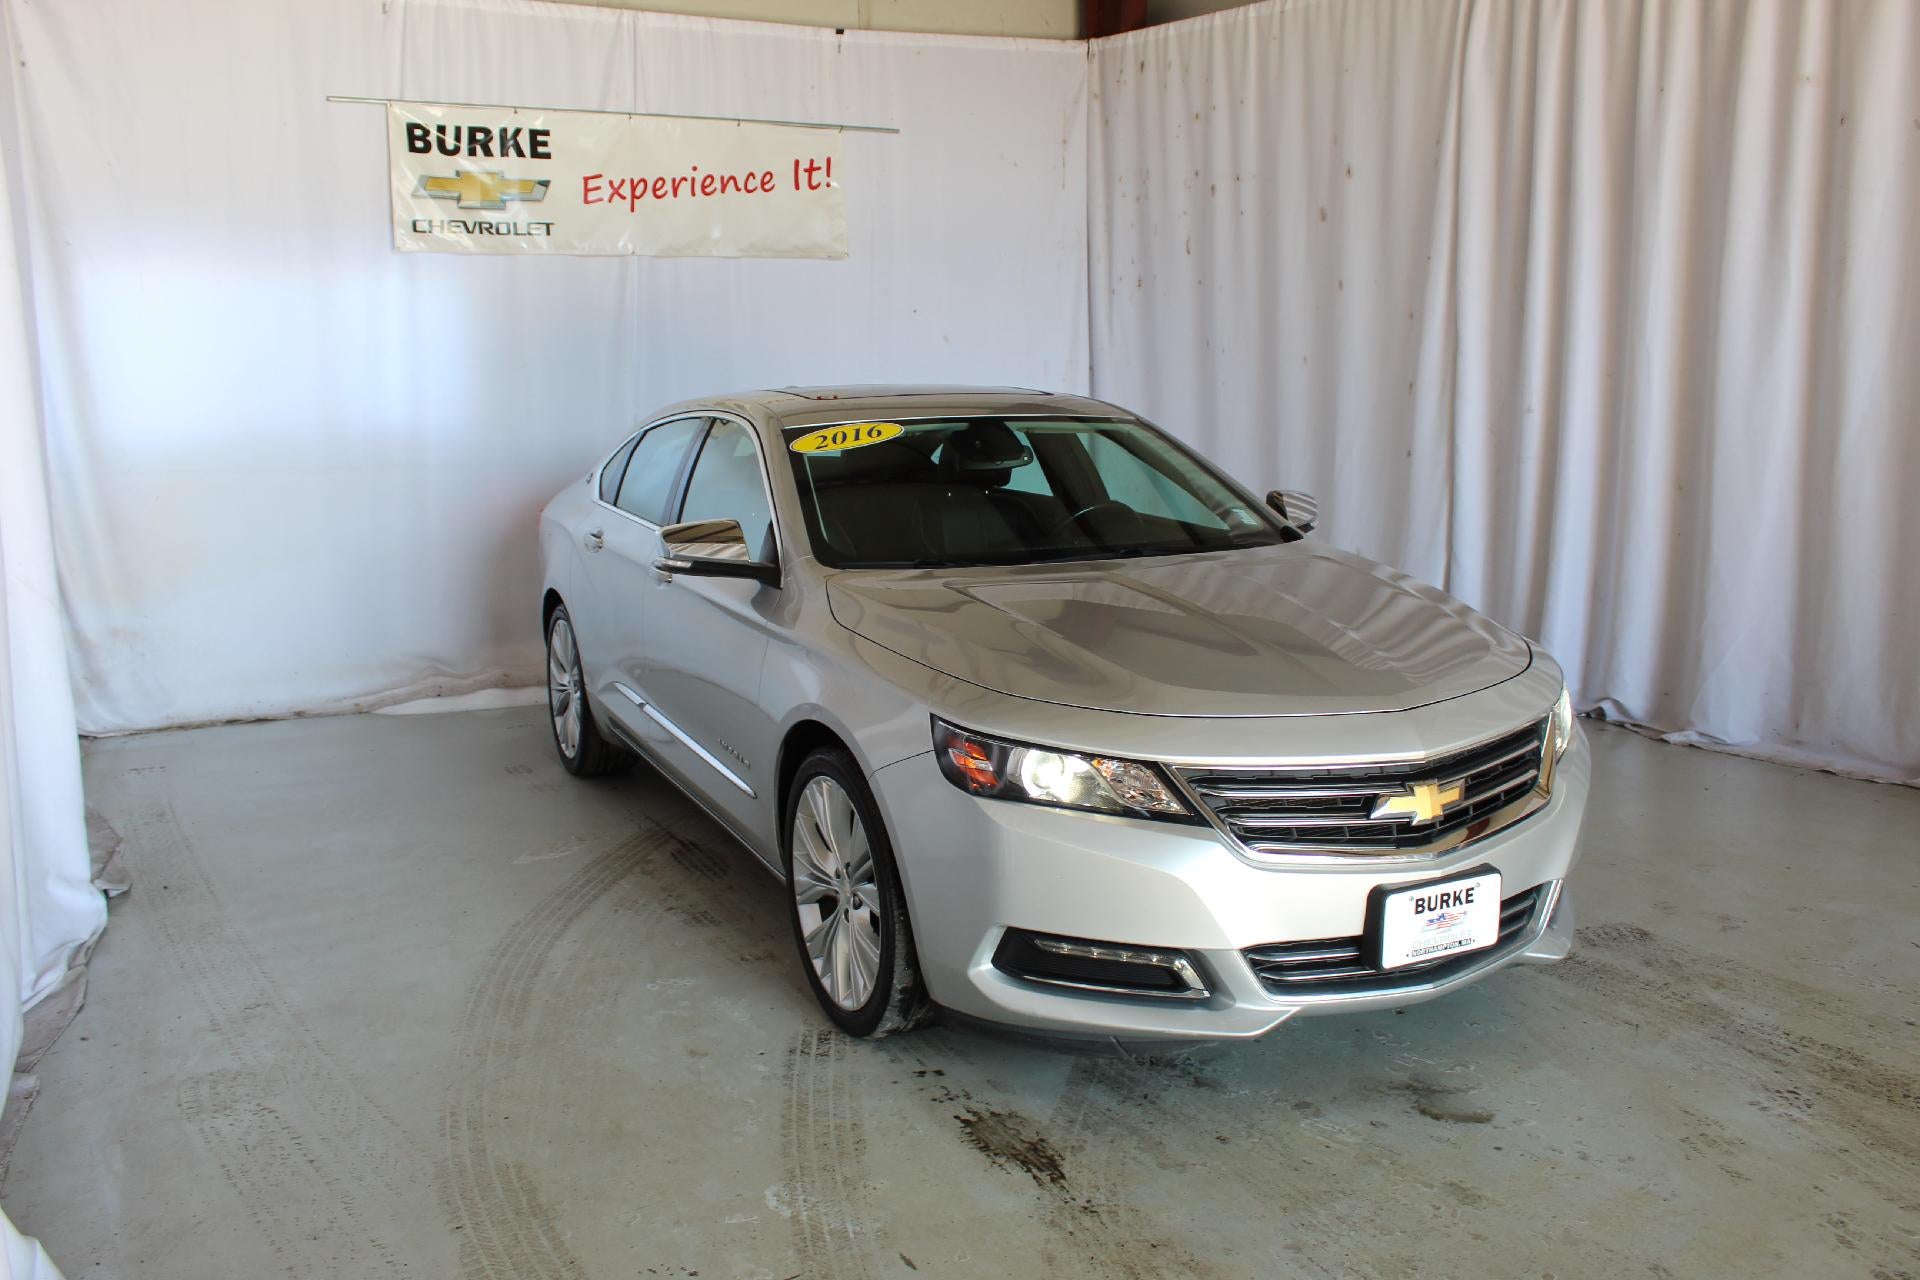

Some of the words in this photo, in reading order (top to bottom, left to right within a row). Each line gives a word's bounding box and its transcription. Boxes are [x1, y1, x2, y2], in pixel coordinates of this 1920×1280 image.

[405, 121, 552, 160] BURKE
[583, 165, 776, 213] Experience
[793, 156, 832, 191] It!
[412, 218, 555, 237] CHEVROLET
[815, 424, 882, 450] 2016
[1414, 886, 1475, 915] BURKE
